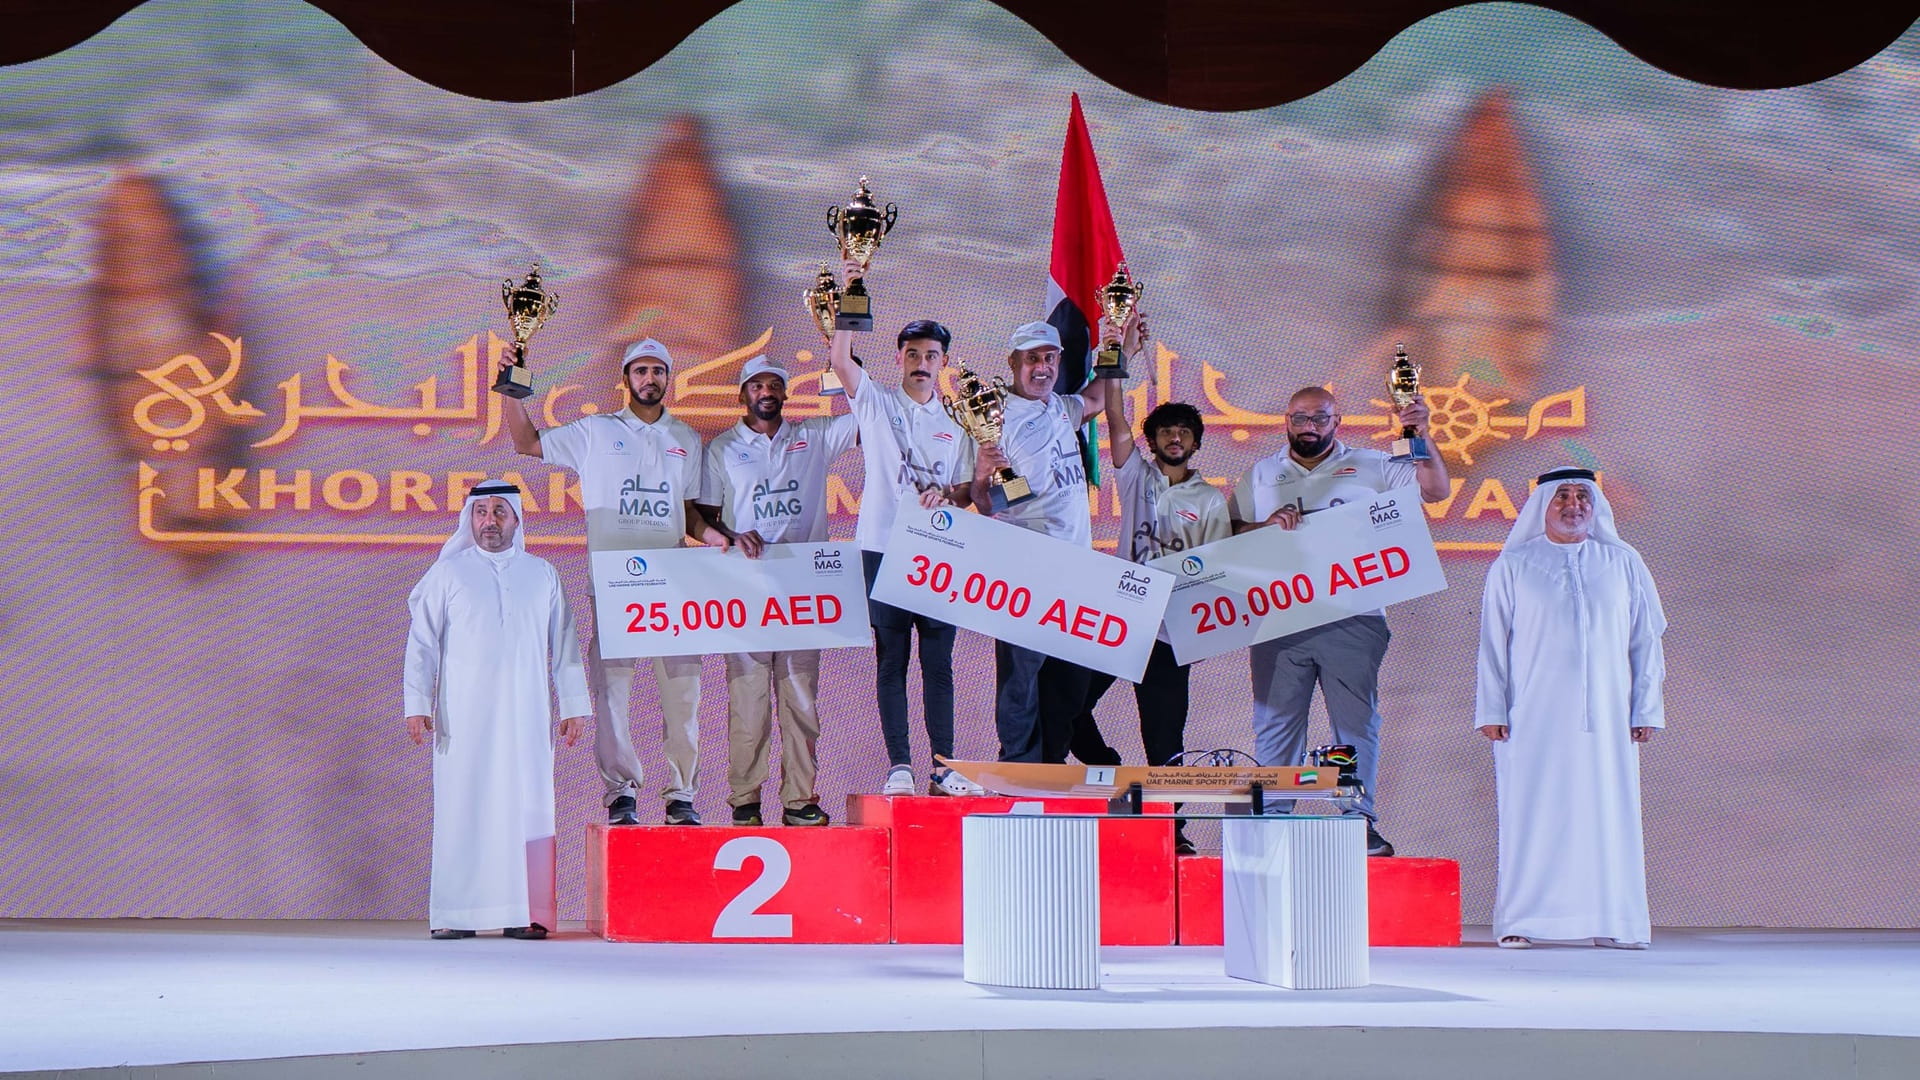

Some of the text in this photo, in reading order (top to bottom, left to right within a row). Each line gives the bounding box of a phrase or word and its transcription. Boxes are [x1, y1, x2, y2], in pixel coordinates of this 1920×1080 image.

[197, 467, 588, 513] KHORFAK
[620, 474, 670, 496] ماج
[752, 478, 799, 502] ماج
[619, 498, 670, 518] MAG
[753, 498, 803, 521] MAG
[1371, 509, 1400, 525] MAG
[814, 559, 842, 570] MAG
[1118, 579, 1147, 596] MAG
[1190, 546, 1410, 635] 20,000 AED
[906, 554, 1129, 648] 30,000 AED
[625, 594, 842, 637] 25,000 AED
[1146, 778, 1278, 786] UAE MARINE SPORTS FEDERATION
[711, 836, 793, 938] 2
